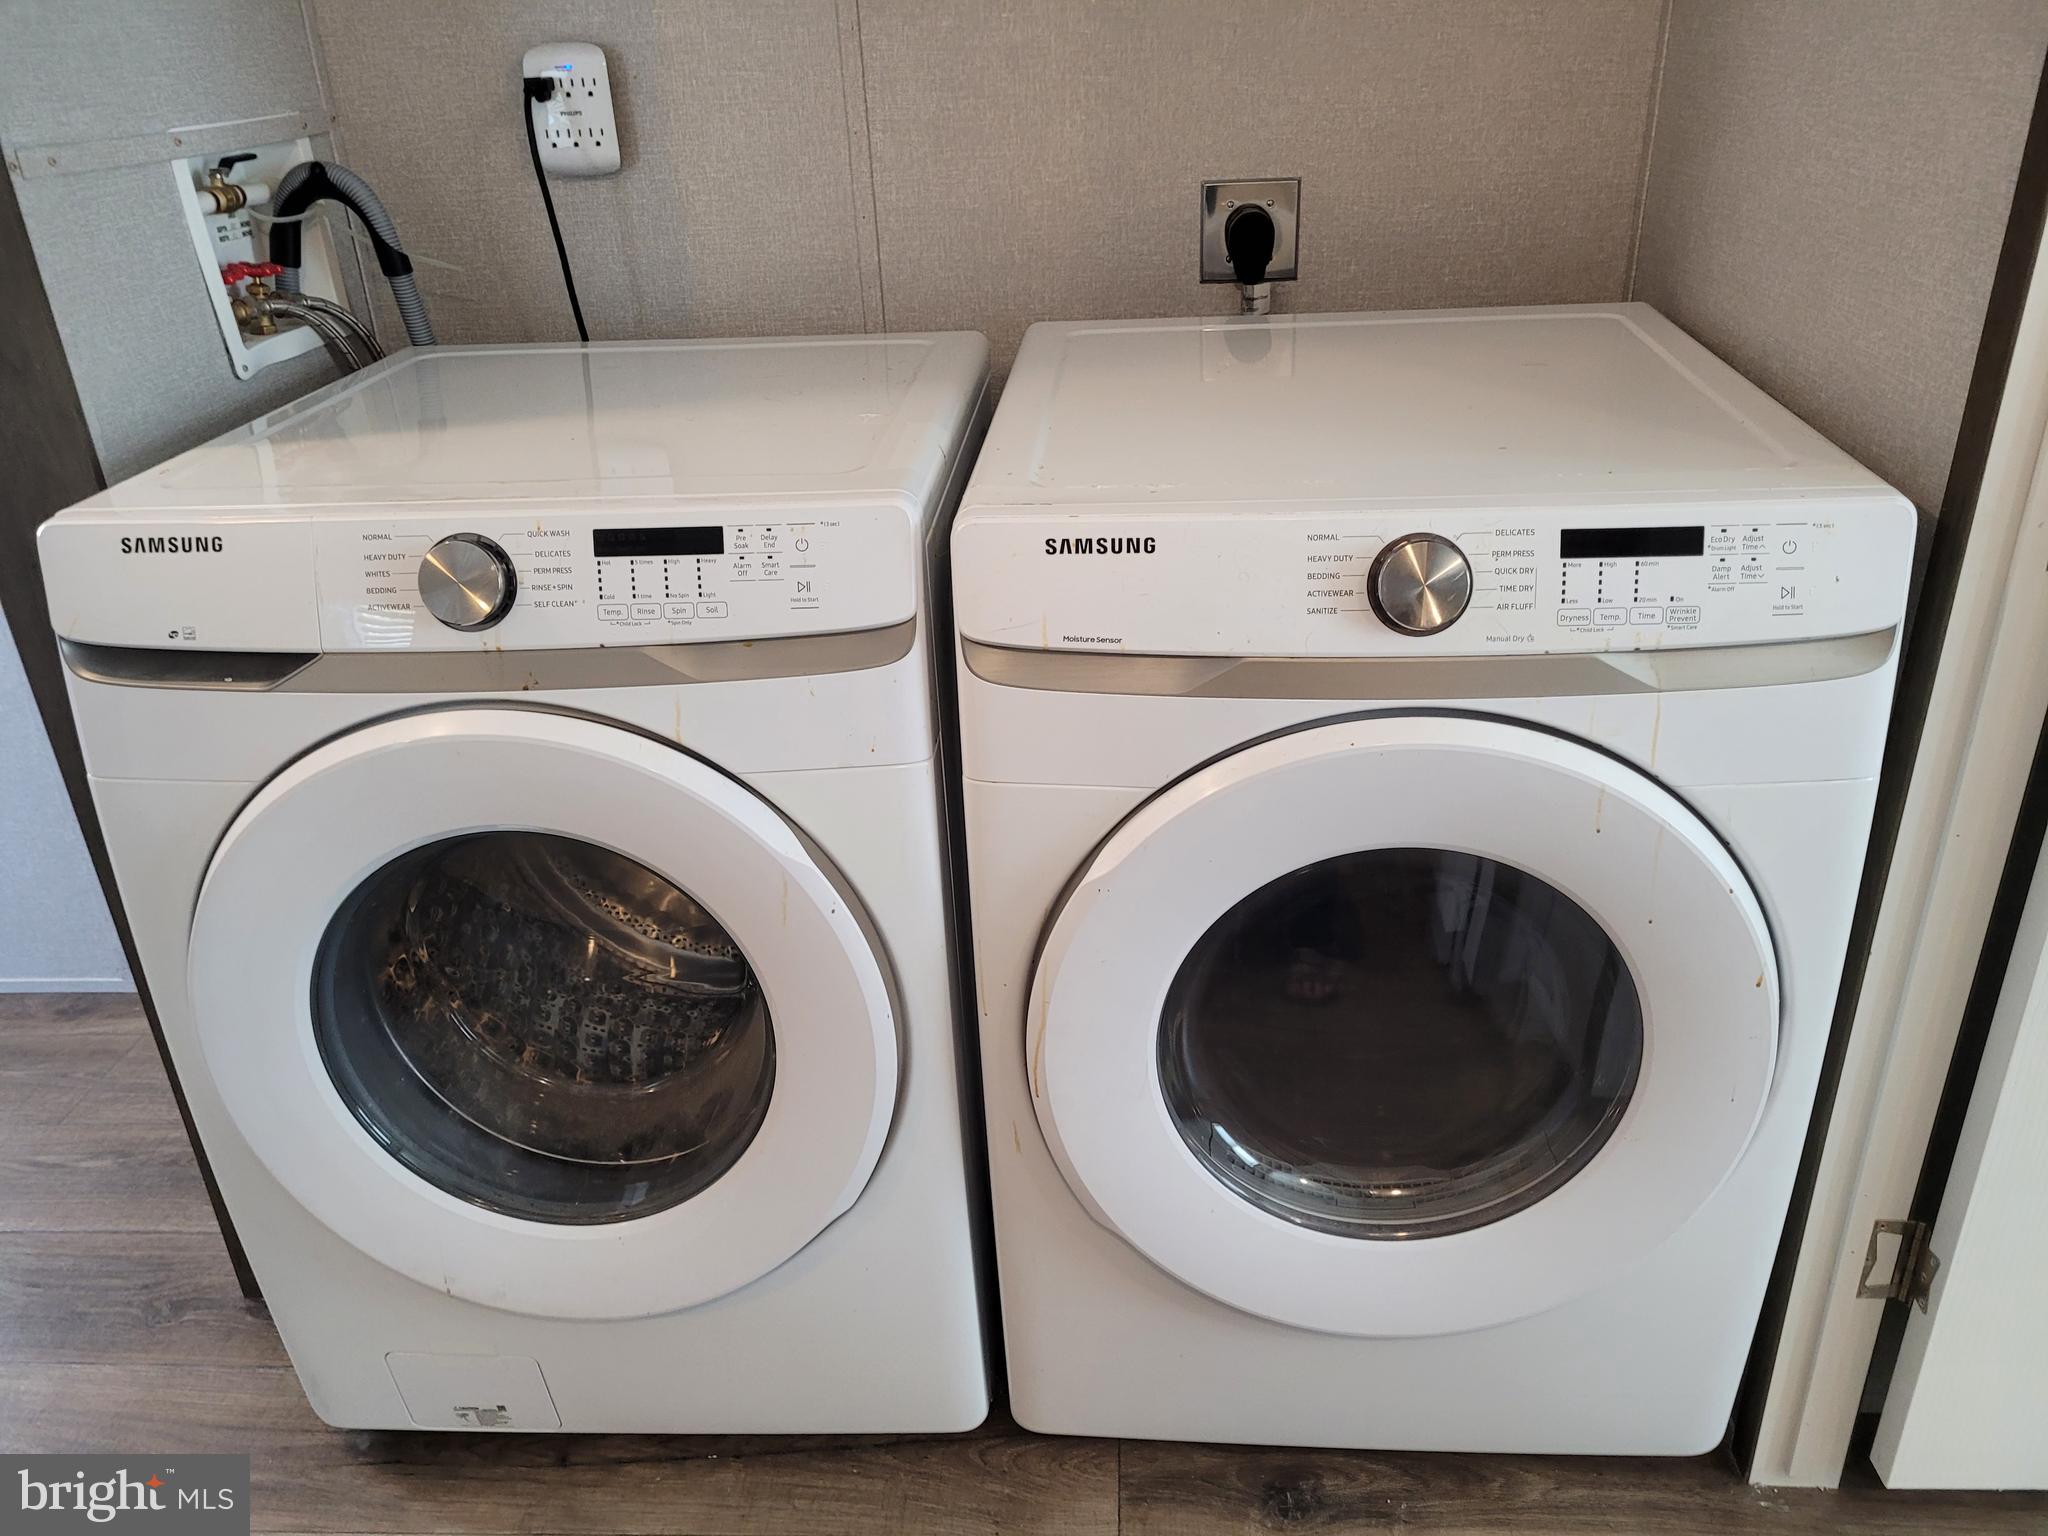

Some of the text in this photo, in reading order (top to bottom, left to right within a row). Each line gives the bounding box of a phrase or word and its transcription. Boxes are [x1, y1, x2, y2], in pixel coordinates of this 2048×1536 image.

[1723, 536, 1736, 544] Dry
[121, 537, 223, 554] SAMSUNG
[1045, 537, 1156, 555] SAMSUNG
[1492, 550, 1512, 558] PERM
[1494, 567, 1535, 575] QUICK DRY
[1711, 565, 1732, 573] Damp
[1307, 572, 1341, 580] BEDDING
[368, 603, 411, 611] ACTIVEWEAR
[706, 606, 719, 614] Soil
[1511, 602, 1534, 610] FLUFF
[603, 608, 623, 616] Temp.
[671, 607, 687, 615] Spin
[1669, 607, 1697, 615] Wrinkle
[1560, 614, 1589, 622] Dryness
[1600, 613, 1621, 622] Temp.
[1638, 612, 1656, 620] Time
[1063, 635, 1095, 643] Moisture
[1512, 635, 1525, 644] Dry
